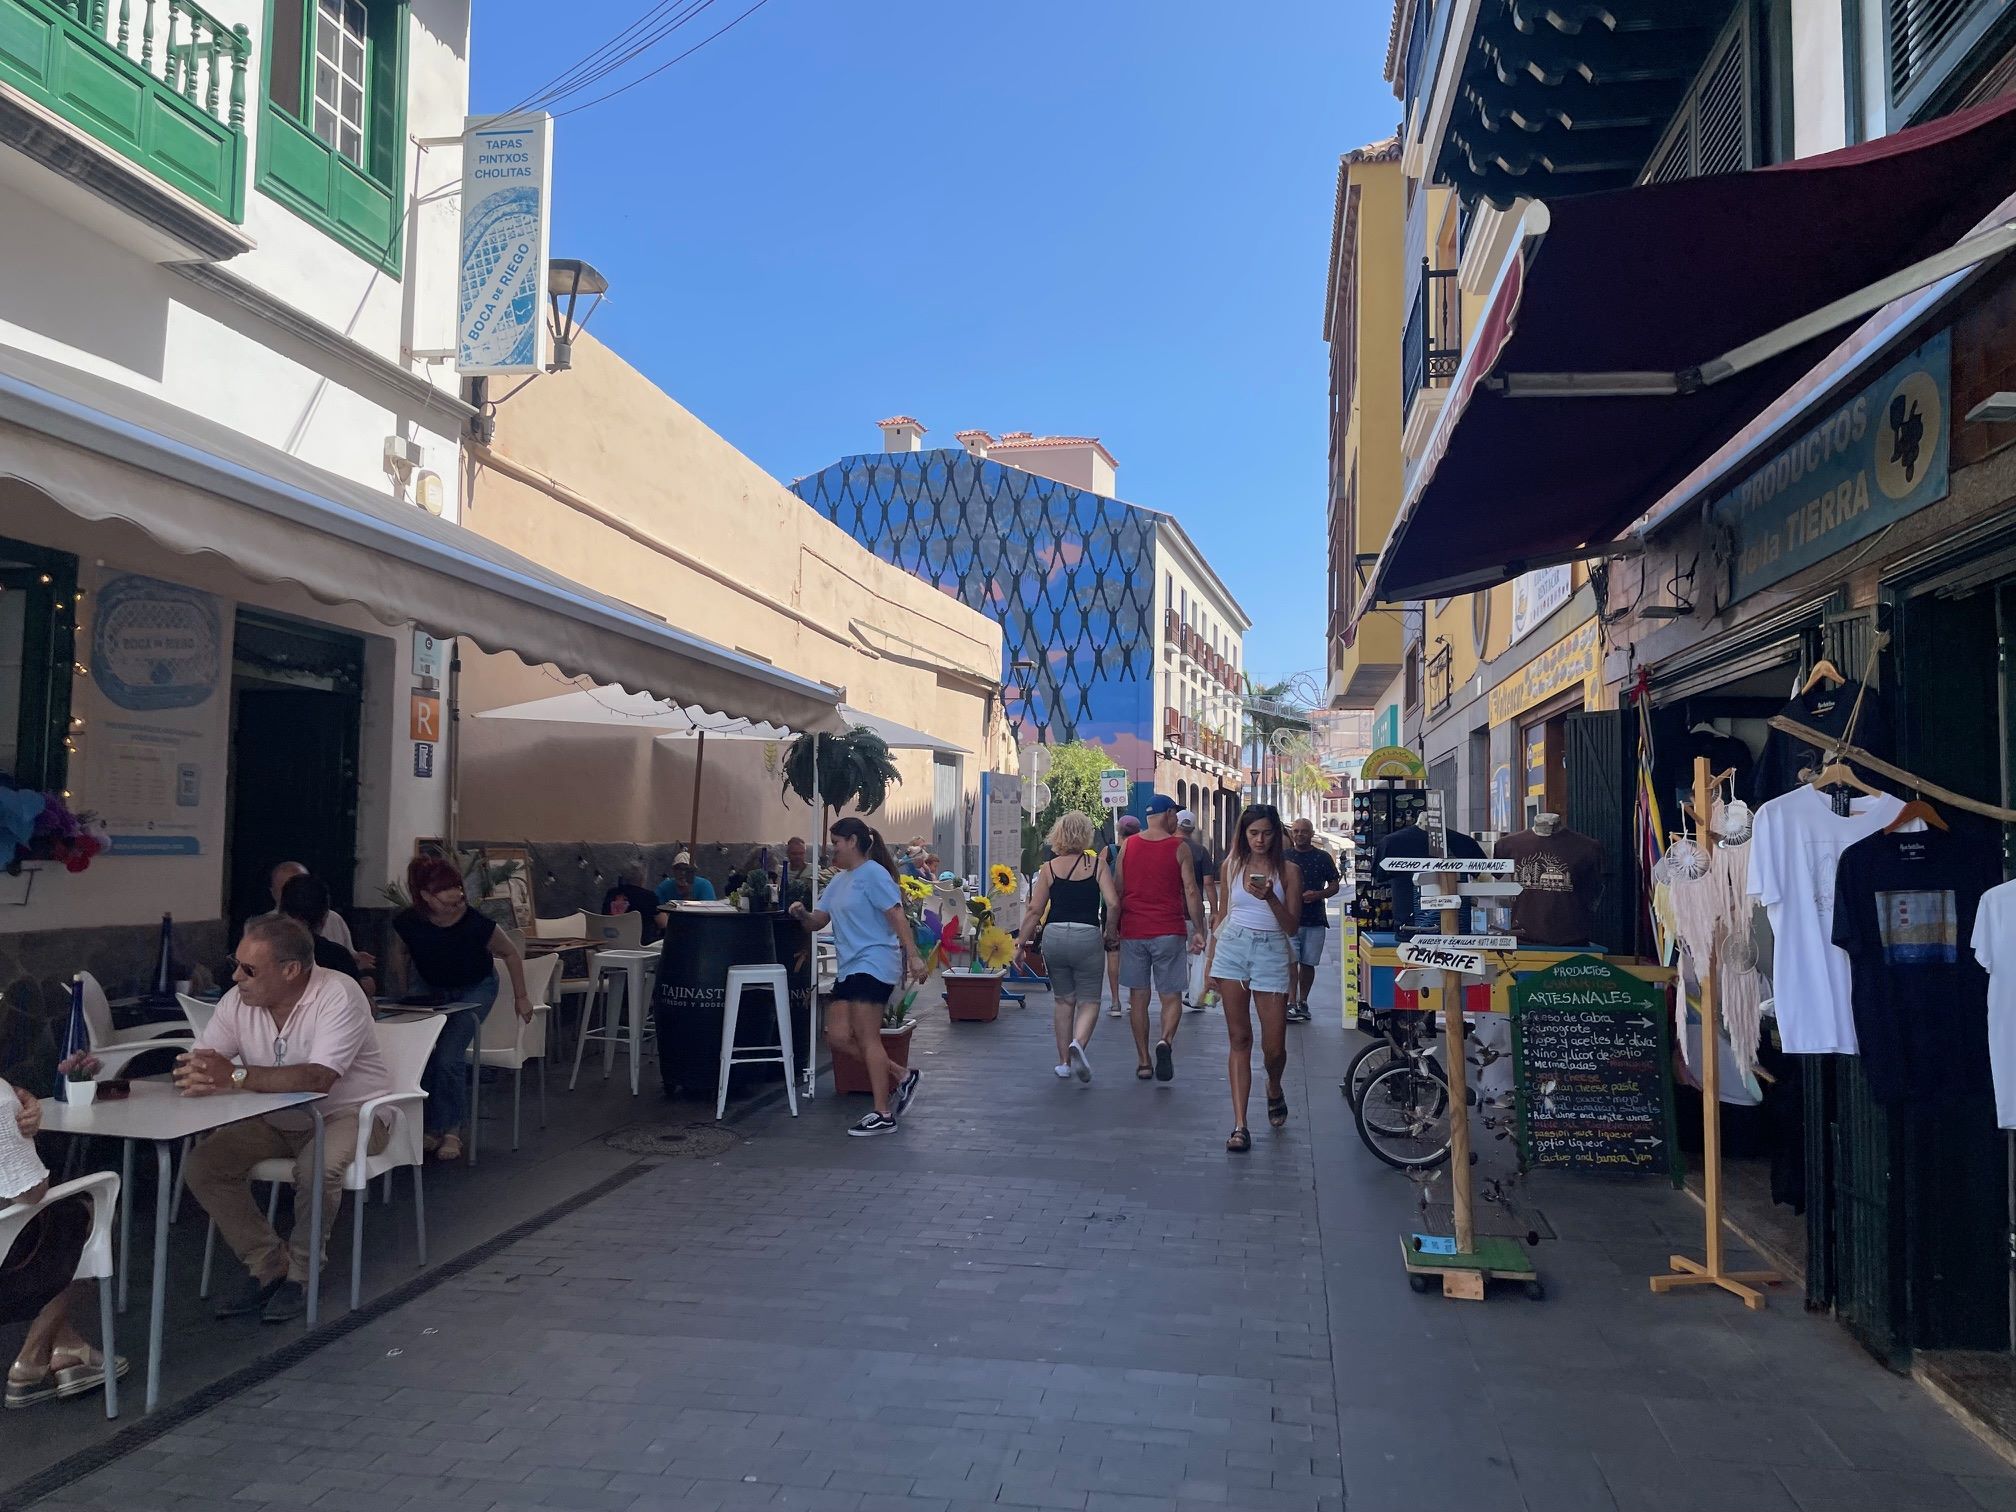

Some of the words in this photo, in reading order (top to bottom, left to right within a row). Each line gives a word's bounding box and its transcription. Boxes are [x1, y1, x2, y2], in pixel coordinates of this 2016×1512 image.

[485, 138, 523, 150] TAPAS
[478, 153, 529, 164] PINTXOS
[474, 167, 532, 179] CHOLITAS
[468, 303, 497, 341] BOCA
[493, 286, 504, 301] DE
[499, 242, 530, 286] RIEGO
[1741, 396, 1868, 519] PRODUCTOS
[1764, 529, 1780, 565] la
[1785, 469, 1870, 552] TIERRA
[417, 702, 433, 735] R
[1388, 861, 1421, 869] HECHO
[1422, 861, 1431, 869] A
[1432, 861, 1464, 870] MANO
[1407, 945, 1479, 969] TENERIFE
[1553, 966, 1611, 978] PRODUCTOS
[661, 983, 726, 1000] TAJINAST
[1528, 991, 1632, 1006] ARTESANALES
[1563, 1012, 1577, 1023] de
[1580, 1012, 1615, 1024] Cabra
[1557, 1039, 1568, 1049] y
[1571, 1033, 1611, 1046] aceites
[1614, 1034, 1625, 1046] de
[1532, 1048, 1558, 1059] Vino
[1571, 1049, 1593, 1061] licor
[1597, 1049, 1610, 1061] de
[1535, 1060, 1597, 1071] Mermeladas
[1611, 1080, 1640, 1095] paste
[1533, 1111, 1554, 1120] Red
[1555, 1111, 1577, 1120] wine
[1579, 1111, 1595, 1120] and
[1597, 1111, 1624, 1122] white
[1625, 1114, 1653, 1122] wine
[1537, 1138, 1565, 1152] gofio
[1568, 1137, 1605, 1152] liqueur
[1575, 1150, 1593, 1161] and
